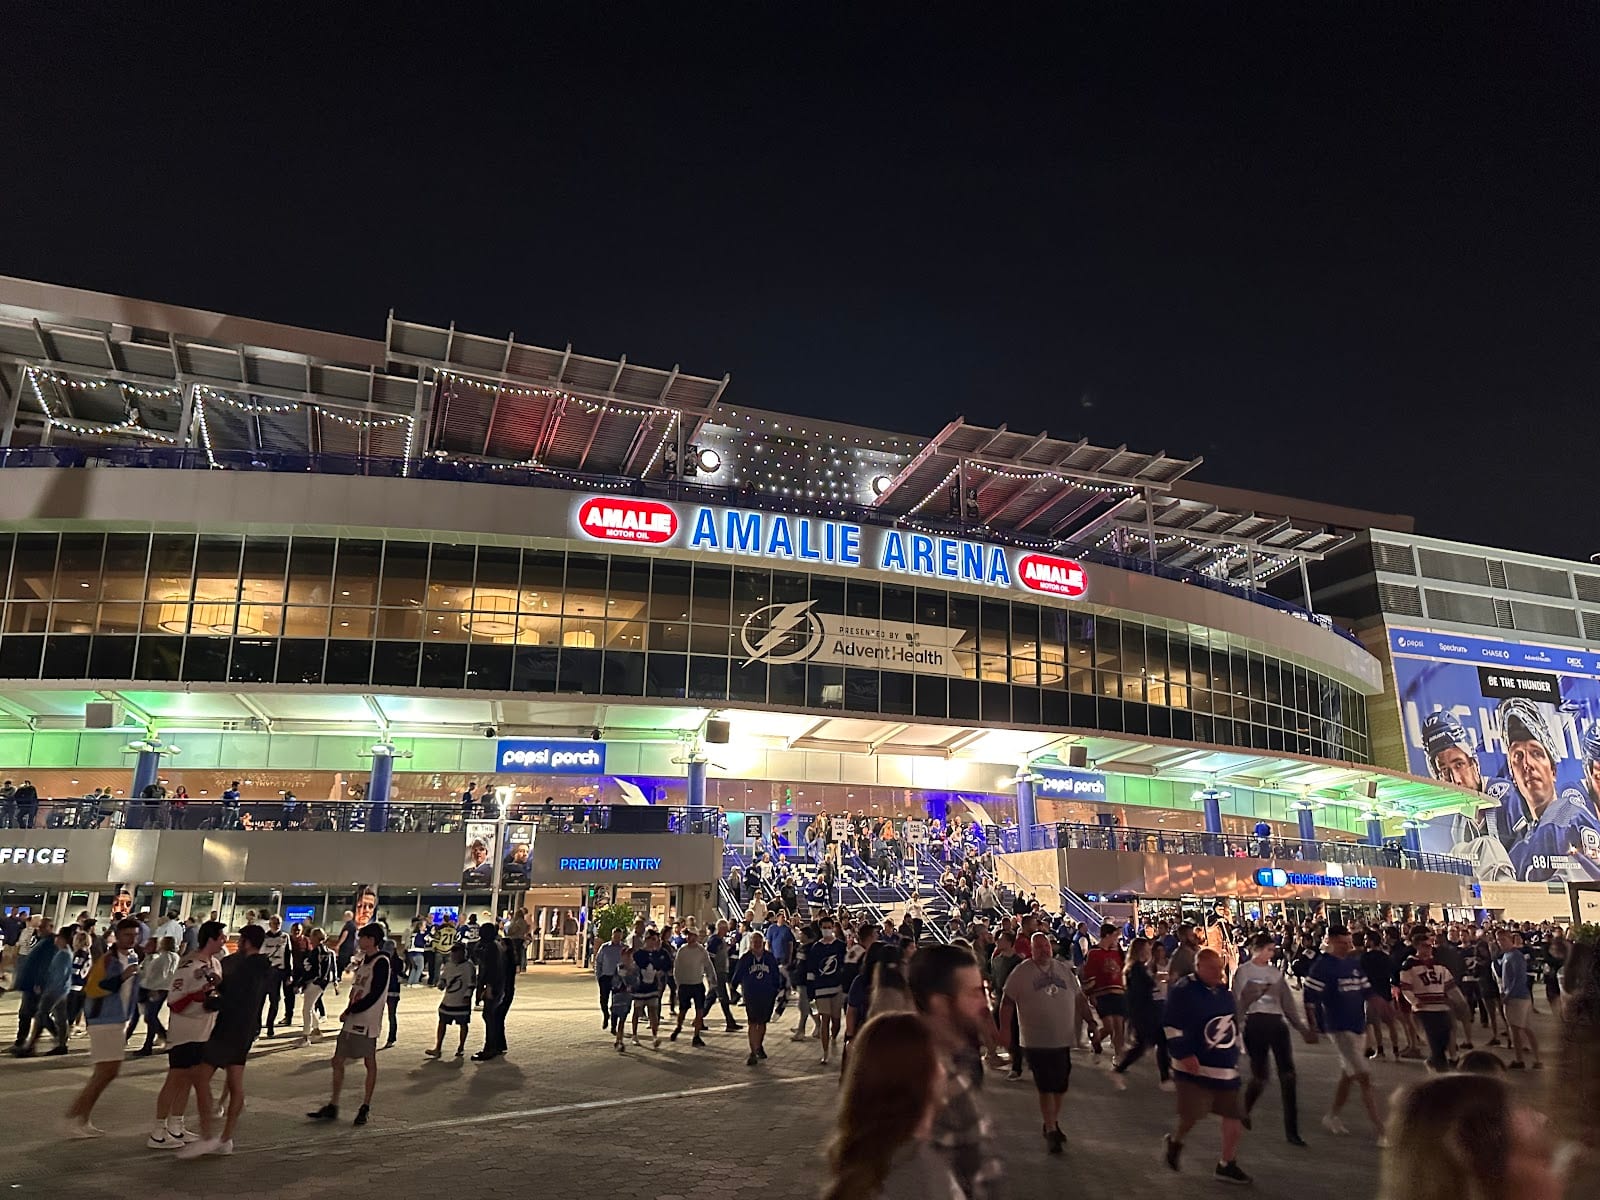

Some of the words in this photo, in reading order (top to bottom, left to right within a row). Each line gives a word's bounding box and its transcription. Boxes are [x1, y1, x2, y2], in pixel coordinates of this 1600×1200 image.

[585, 506, 672, 535] AMALIE
[605, 528, 635, 539] MOTOR
[635, 531, 650, 541] OIL
[690, 507, 862, 565] AMALIE
[880, 530, 1012, 586] ARENA
[1025, 561, 1084, 590] AMALIE
[1039, 582, 1060, 592] MOTOR
[1060, 585, 1070, 593] OIL
[839, 626, 885, 639] PRESENTED
[889, 631, 900, 640] BY
[1406, 639, 1425, 649] pepsi
[1438, 642, 1466, 654] Spectrum
[832, 640, 943, 666] AdventHealth
[1481, 648, 1503, 658] CHASE
[1566, 657, 1583, 666] DEX
[1487, 675, 1499, 687] BE
[1499, 676, 1516, 689] THE
[1516, 678, 1552, 693] THUNDER
[502, 748, 549, 767] pepsi
[551, 749, 600, 768] porch
[1042, 777, 1073, 793] pepsi
[1073, 779, 1105, 794] porch
[0, 847, 67, 865] FFICE
[559, 857, 619, 871] PREMIUM
[621, 858, 662, 871] ENTRY
[1287, 872, 1321, 886] TAMPA
[1344, 875, 1377, 889] SPORTS
[441, 933, 454, 946] 21
